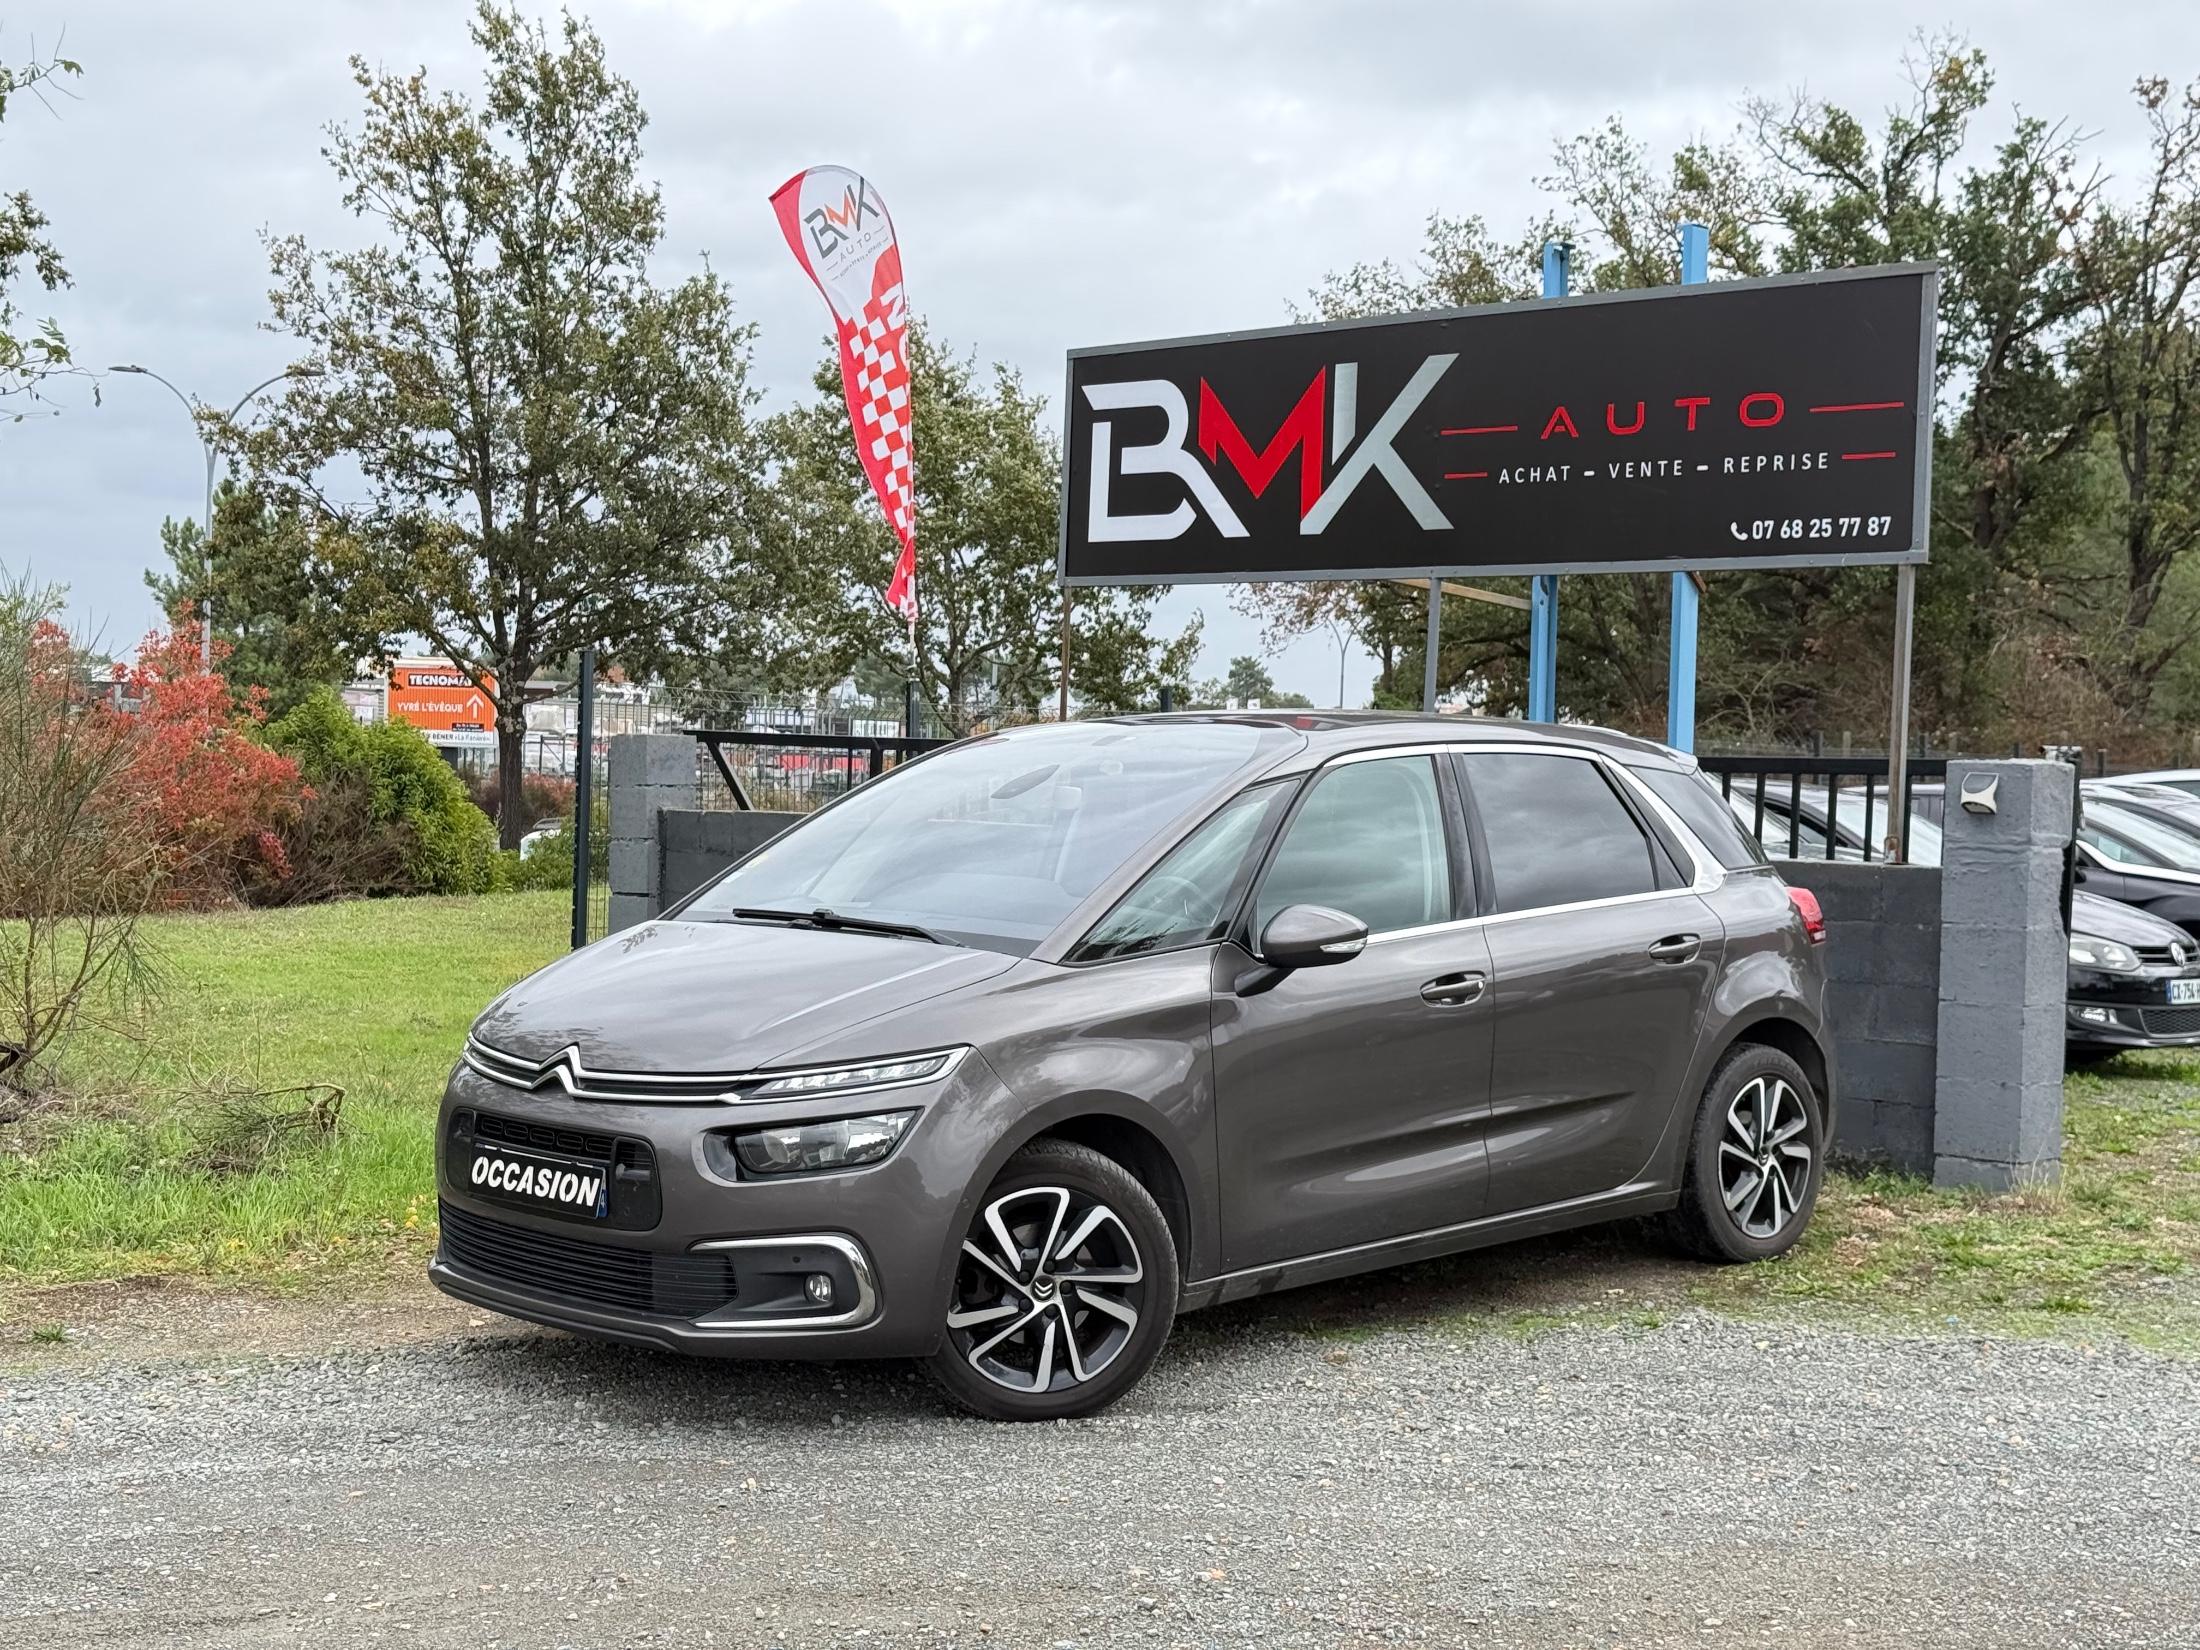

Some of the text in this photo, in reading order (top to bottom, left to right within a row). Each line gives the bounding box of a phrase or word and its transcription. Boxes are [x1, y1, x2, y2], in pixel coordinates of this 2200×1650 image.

[803, 176, 879, 260] BMK
[839, 232, 872, 262] AUTO
[1540, 392, 1785, 440] AUTO
[1081, 353, 1460, 543] BMK
[1499, 465, 1571, 484] ACHAT
[1608, 460, 1684, 479] VENTE
[1723, 452, 1830, 474] REPRISE
[1751, 516, 1892, 539] 07 68 25 77 87
[397, 699, 464, 713] YVRÉ L'ÉVÊQUE
[471, 1156, 600, 1207] OCCASION
